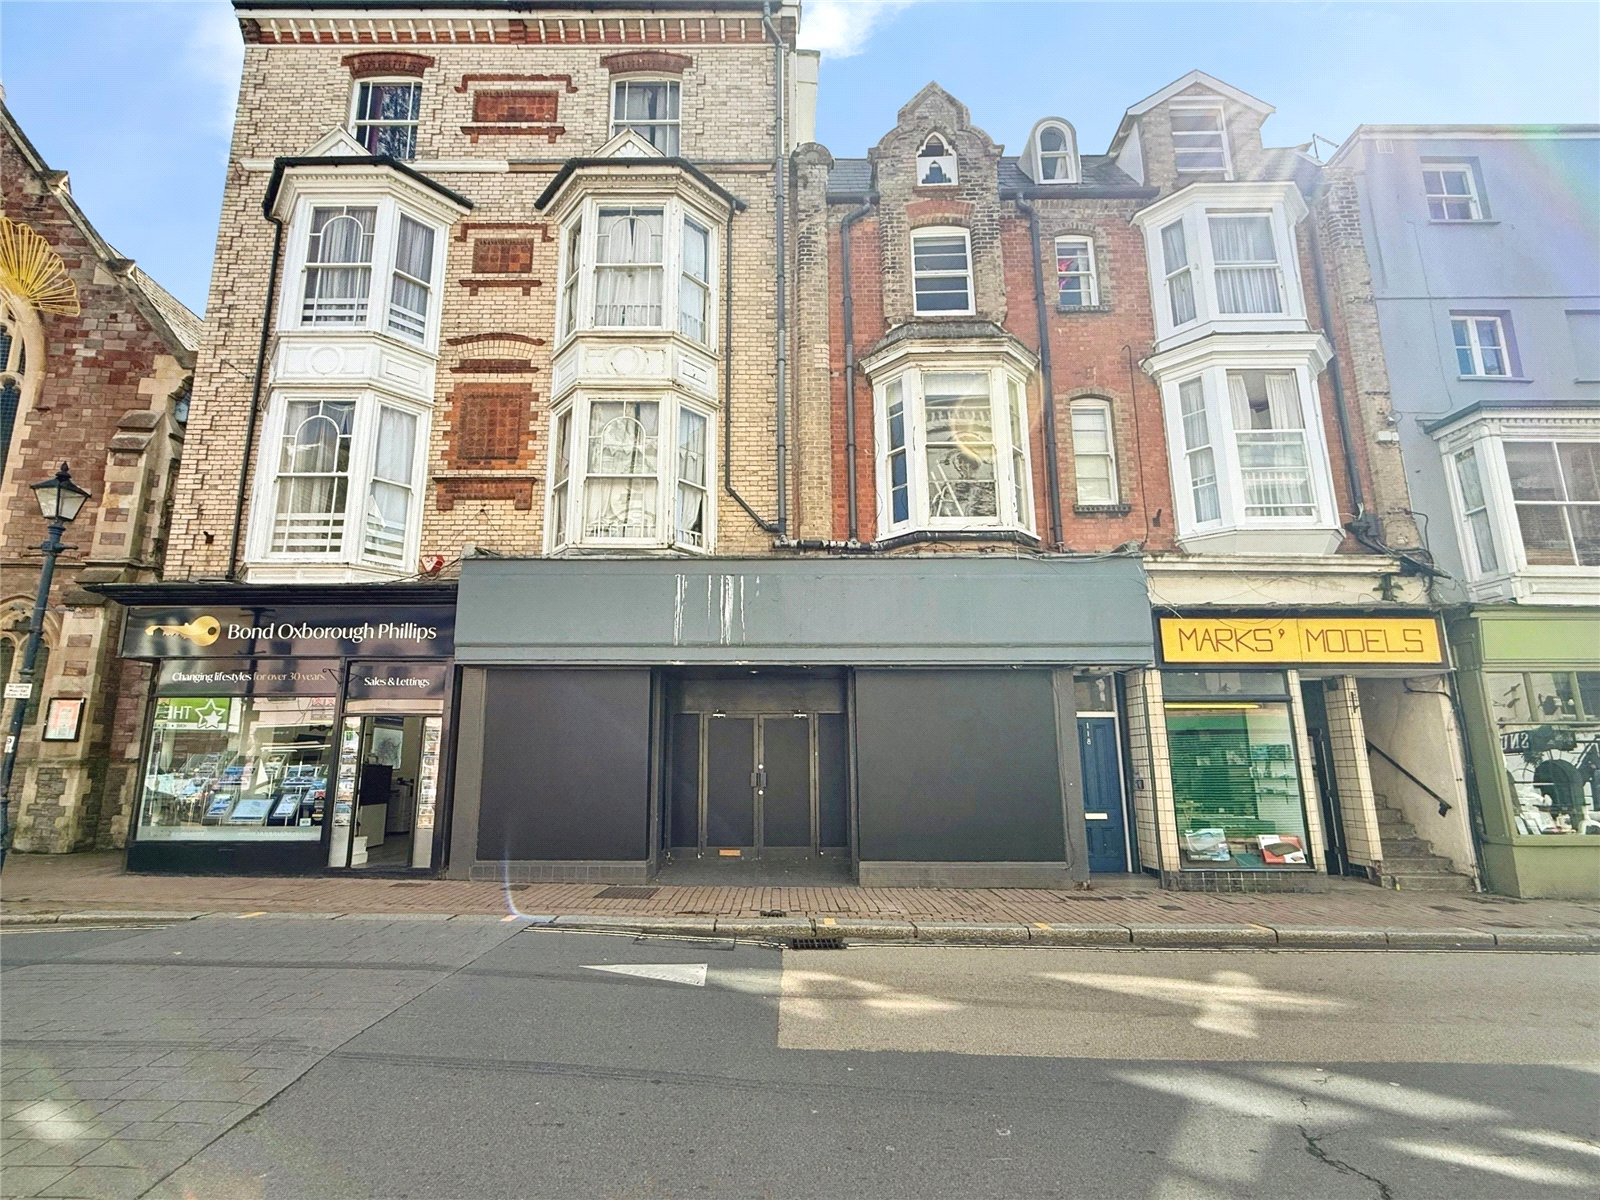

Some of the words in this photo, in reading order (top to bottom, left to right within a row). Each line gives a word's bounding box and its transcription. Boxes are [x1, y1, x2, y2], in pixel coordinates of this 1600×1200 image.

[227, 622, 273, 640] Bond
[277, 622, 374, 643] Oxborough
[378, 622, 437, 643] Phillips
[1178, 627, 1285, 653] MARKS'
[1305, 628, 1424, 653] MODELS
[172, 671, 213, 683] Changing
[214, 671, 251, 683] lifestyles
[253, 671, 267, 681] for
[267, 672, 287, 681] over
[289, 671, 301, 681] 30
[364, 676, 386, 686] Sales
[387, 676, 395, 686] &
[396, 677, 430, 689] Lettings
